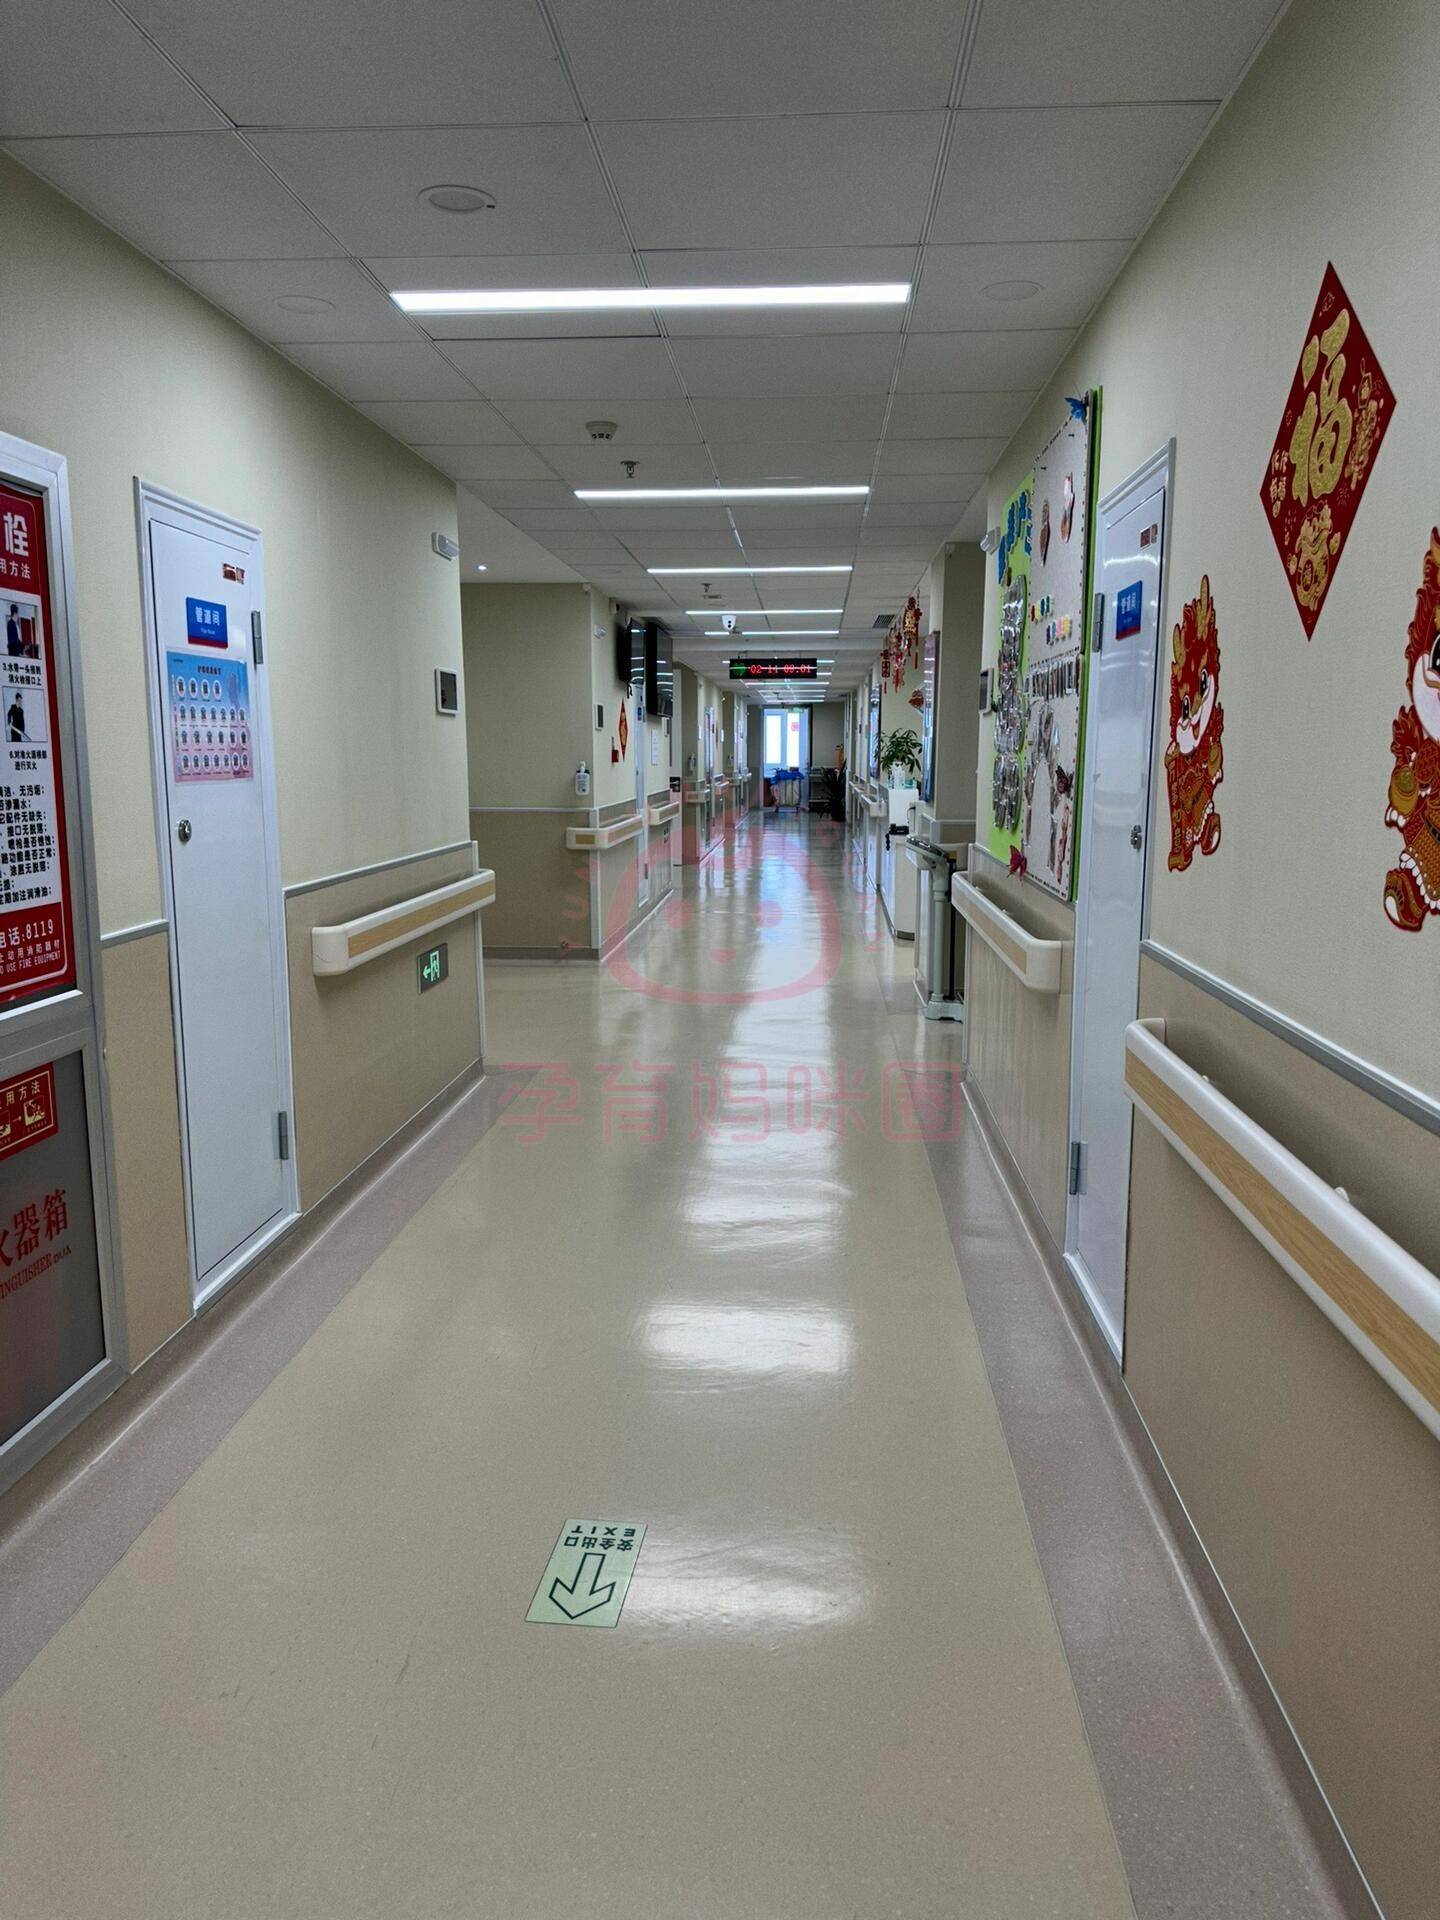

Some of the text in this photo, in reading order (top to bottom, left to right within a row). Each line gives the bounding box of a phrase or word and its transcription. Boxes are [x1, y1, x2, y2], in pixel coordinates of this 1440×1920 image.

[1289, 308, 1353, 507] 福
[3, 511, 29, 557] 栓
[0, 1080, 40, 1110] 用方法
[0, 1252, 52, 1299] INGUISHER
[564, 1536, 634, 1551] 安全出口
[571, 1525, 636, 1537] EXIT
